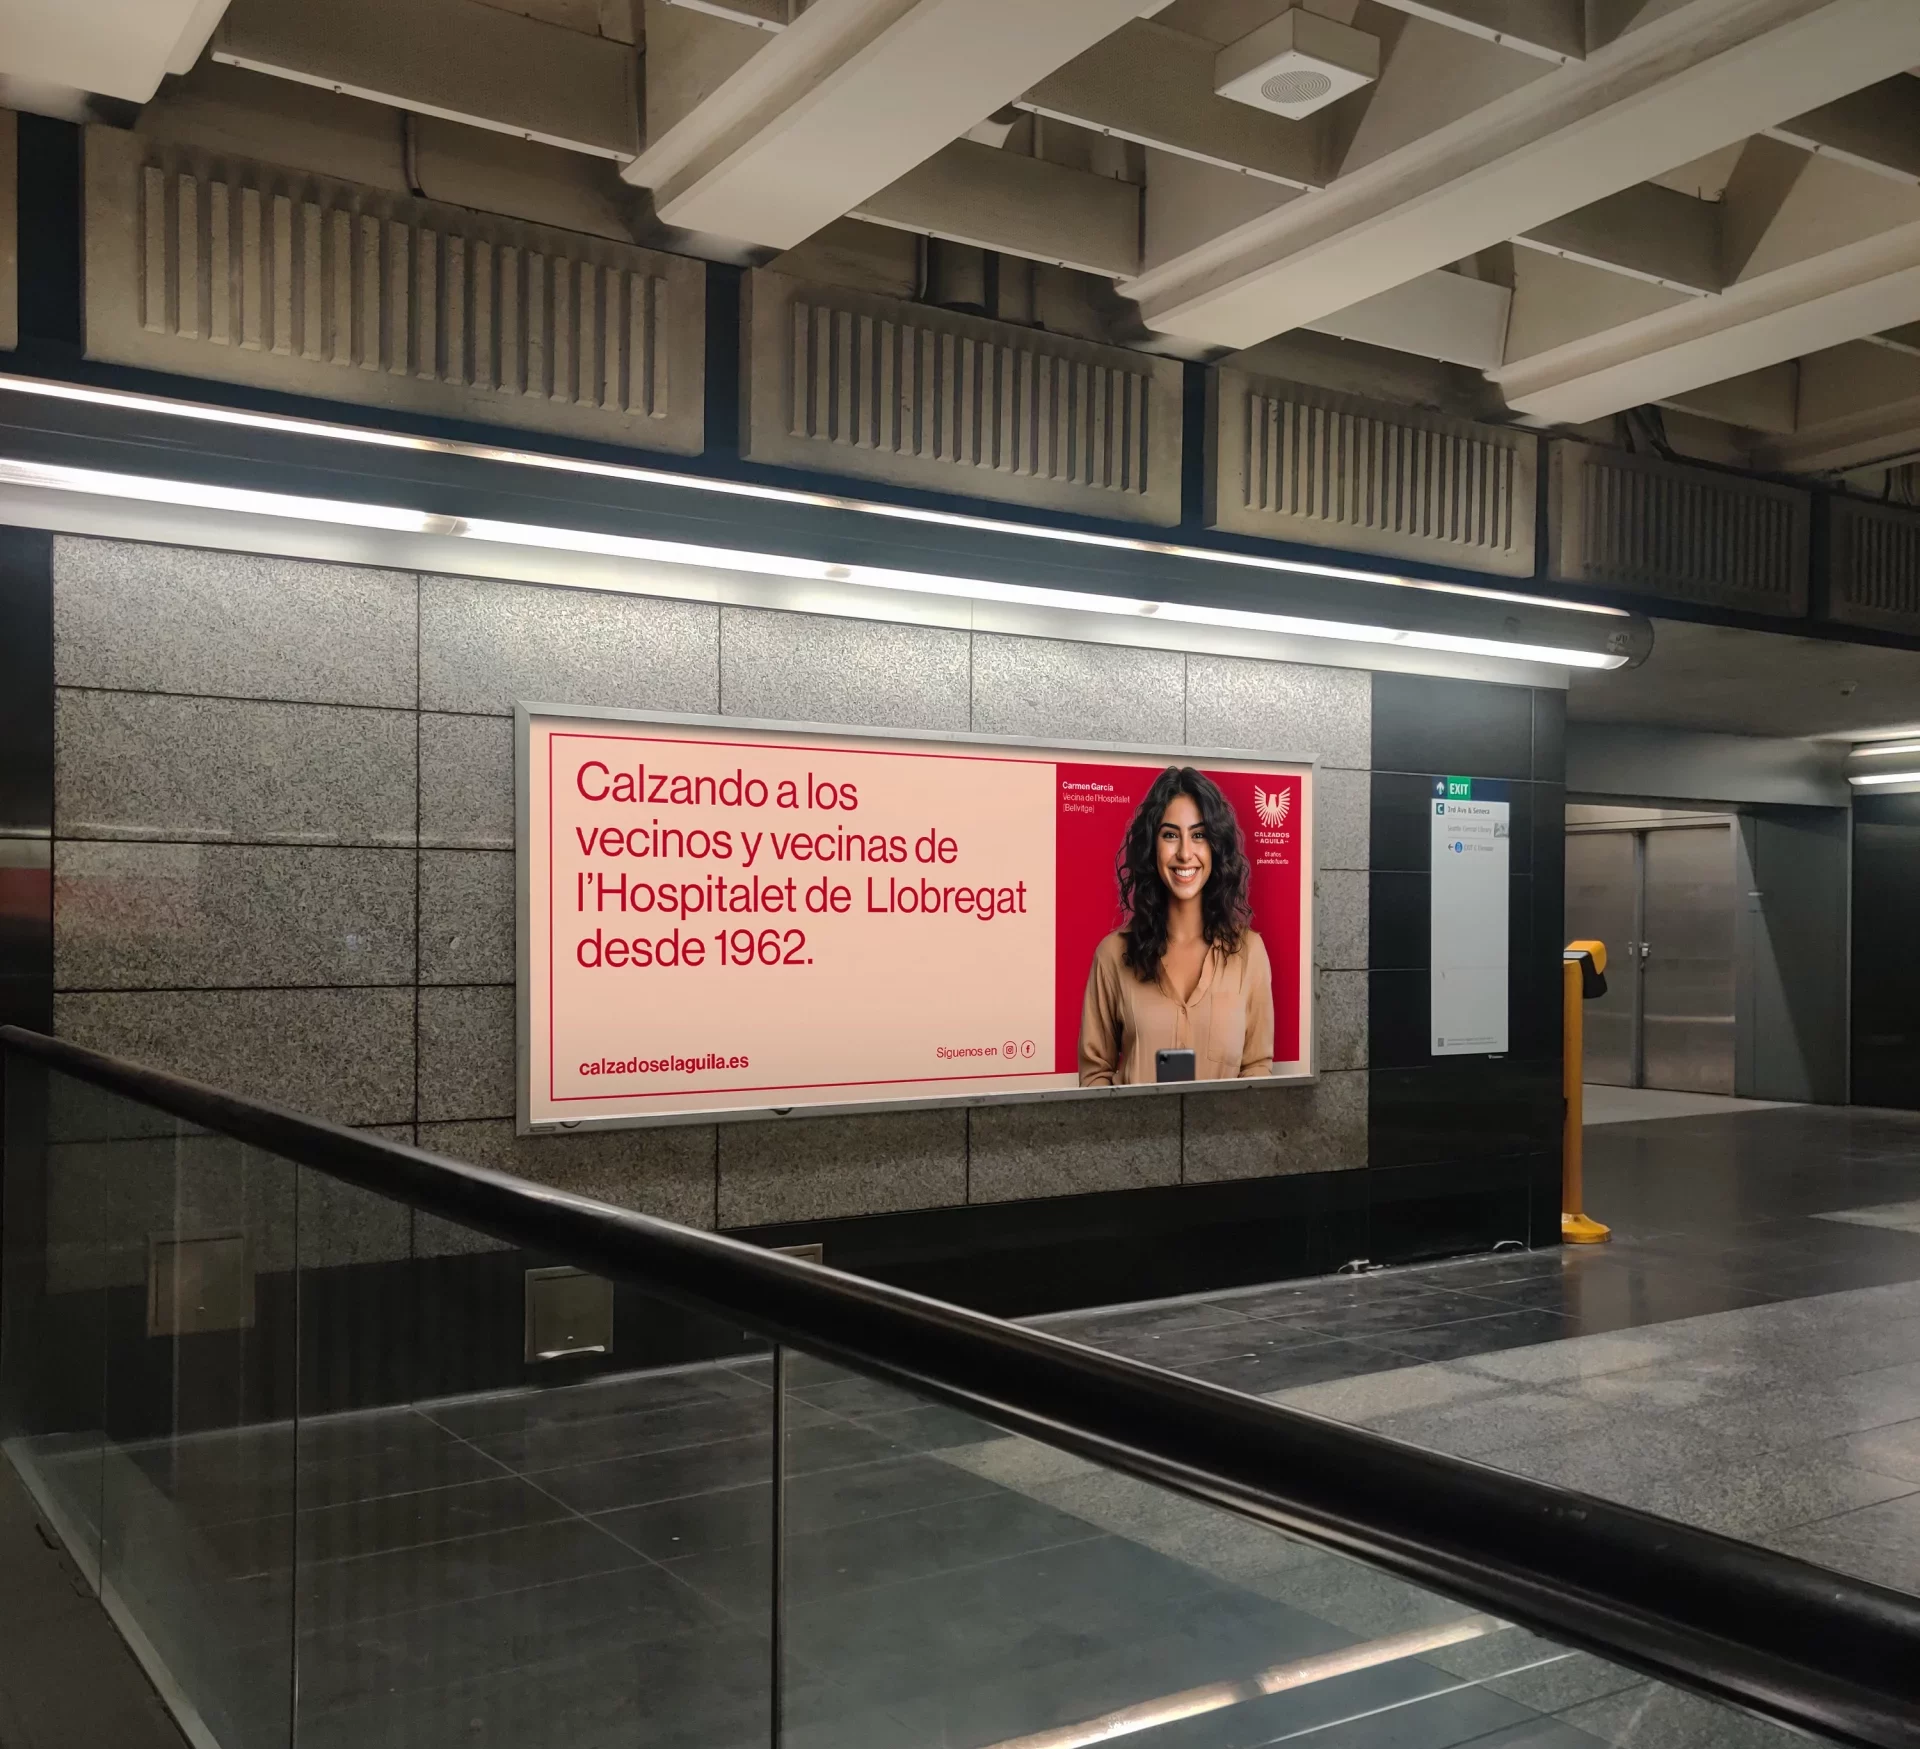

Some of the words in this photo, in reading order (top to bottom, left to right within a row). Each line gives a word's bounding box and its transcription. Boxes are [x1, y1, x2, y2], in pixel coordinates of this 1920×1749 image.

[577, 761, 768, 807] Calzando
[777, 781, 799, 810] a
[808, 772, 858, 811] los
[1062, 781, 1090, 790] Carmen
[1449, 783, 1468, 795] EXIT
[1062, 793, 1084, 801] Vecina
[1085, 794, 1095, 802] de
[1457, 806, 1466, 814] Ave
[576, 819, 732, 859] vecinos
[741, 832, 763, 867] y
[770, 825, 907, 863] vecinas
[915, 828, 958, 864] de
[805, 876, 851, 913] de
[868, 877, 1026, 921] Llobregat
[577, 928, 705, 968] desde
[715, 929, 813, 966] 1962.
[984, 1047, 998, 1056] en
[579, 1053, 749, 1075] calzadoselaguila.es
